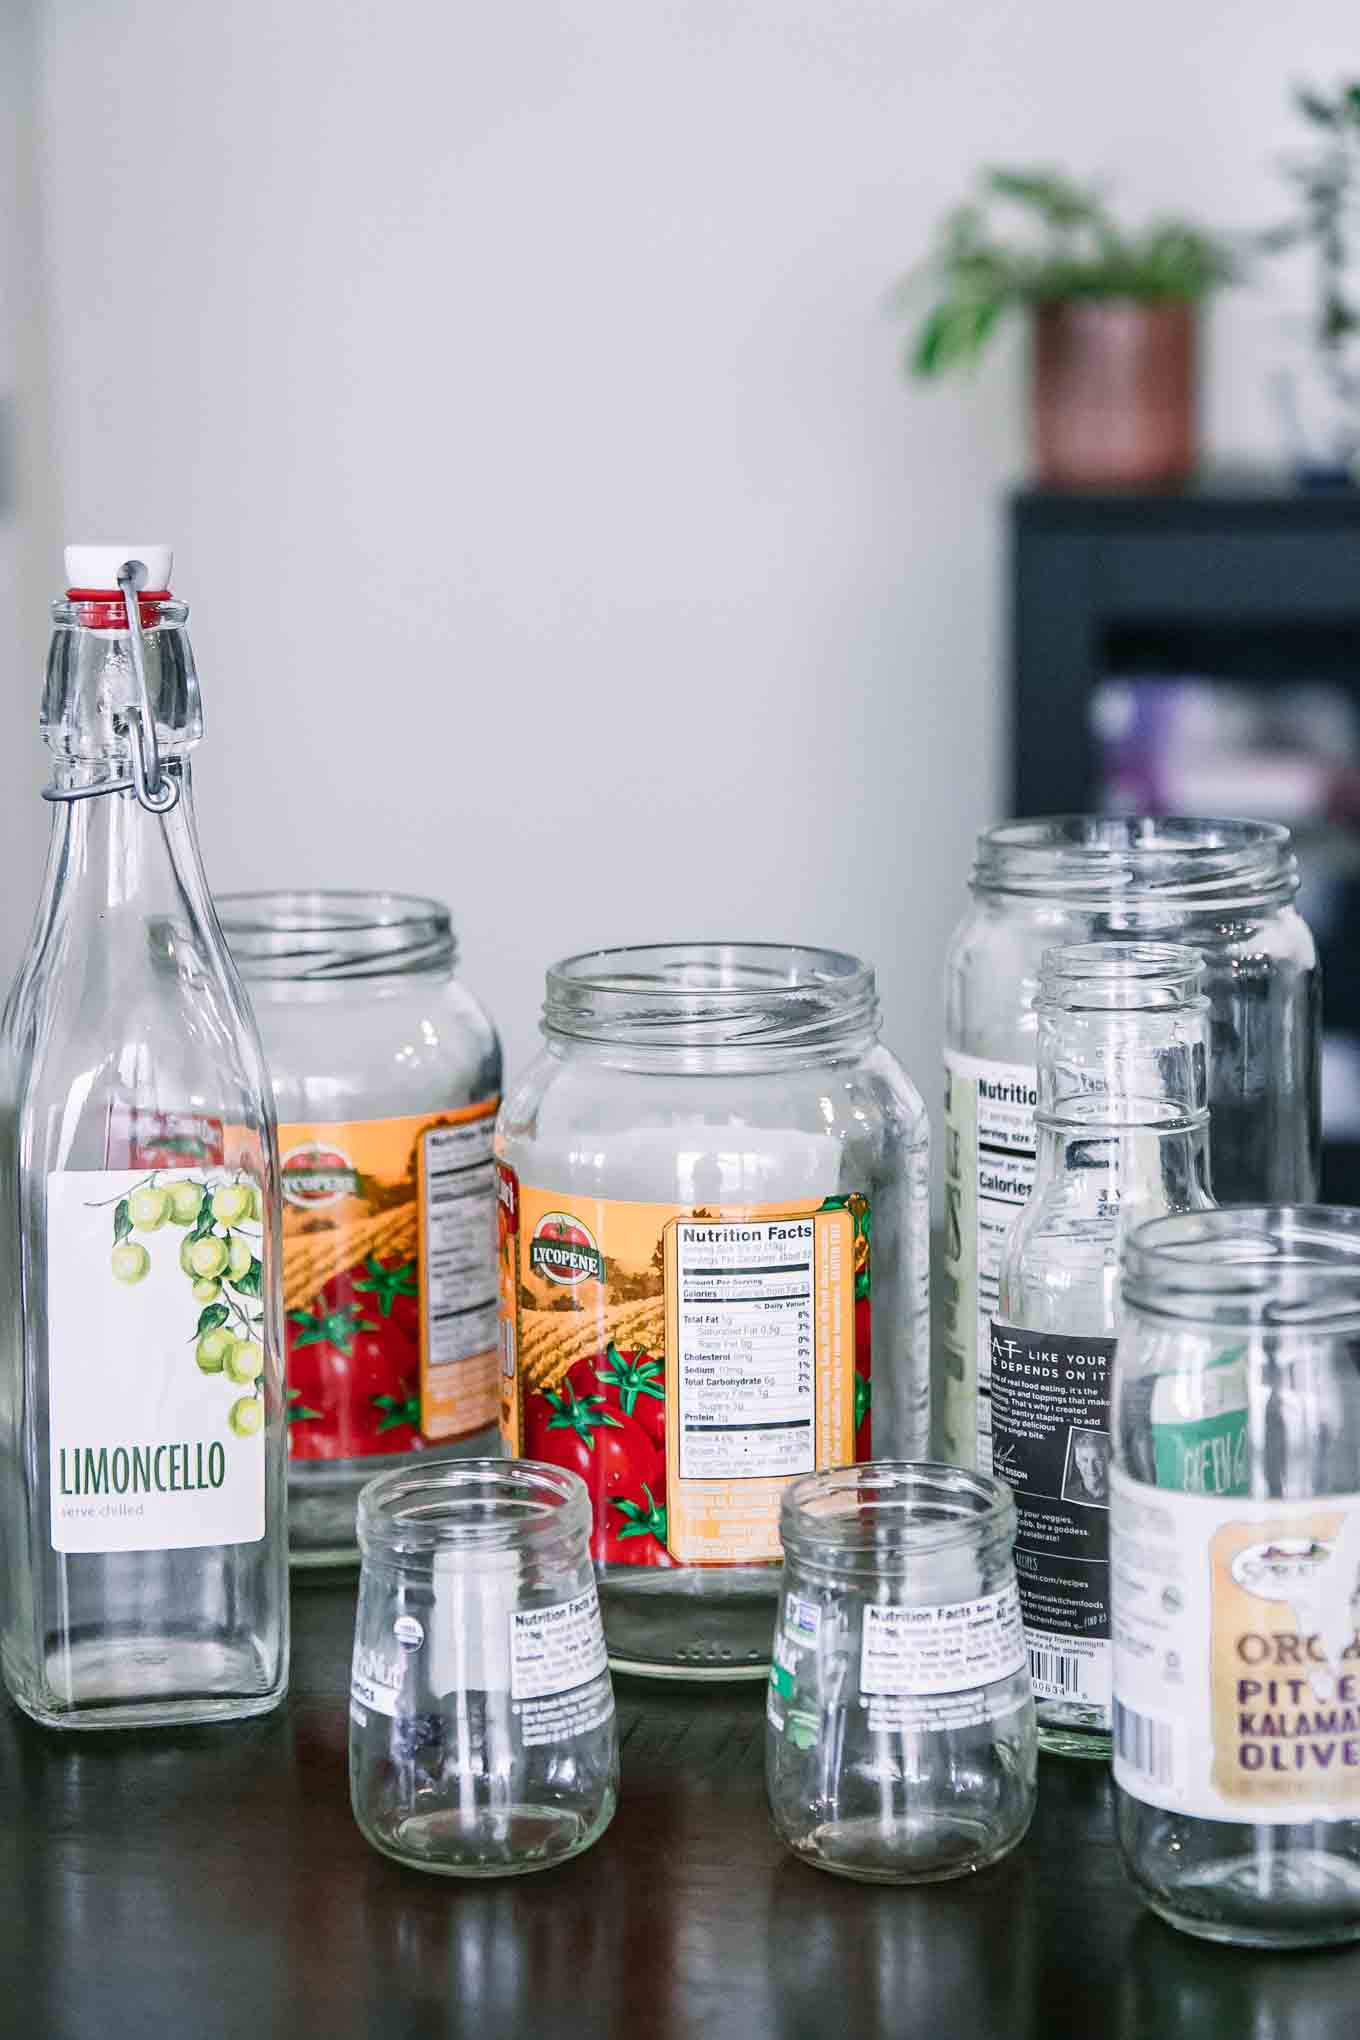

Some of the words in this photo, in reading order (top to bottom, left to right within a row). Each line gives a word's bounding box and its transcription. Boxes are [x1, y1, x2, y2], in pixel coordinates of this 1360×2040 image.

[979, 1171, 1034, 1197] Calories
[683, 1228, 762, 1243] Nutrition
[768, 1224, 813, 1241] Facts
[533, 1246, 599, 1274] LYCOPENE
[683, 1288, 718, 1298] Calories
[764, 1302, 784, 1311] Daily
[684, 1315, 703, 1324] Total
[705, 1315, 719, 1324] Fat
[684, 1353, 731, 1361] Cholesterol
[1028, 1350, 1059, 1364] LIKE
[1066, 1353, 1107, 1367] YOUR
[684, 1365, 715, 1374] Sodium
[1000, 1359, 1059, 1379] DEPENDS
[1065, 1369, 1086, 1381] ON
[685, 1377, 704, 1386] Total
[706, 1377, 762, 1387] Carbohydrate
[1021, 1380, 1039, 1390] food
[1032, 1392, 1067, 1405] toppings
[1068, 1396, 1086, 1405] that
[1033, 1403, 1050, 1413] why
[1055, 1406, 1088, 1416] created
[685, 1413, 715, 1422] Protein
[1011, 1409, 1034, 1421] pantry
[1035, 1412, 1064, 1424] staples
[1073, 1417, 1082, 1425] to
[1083, 1418, 1101, 1426] add
[1021, 1420, 1056, 1432] delicious
[60, 1441, 225, 1496] LIMONCELLO
[62, 1506, 96, 1518] serve
[1023, 1511, 1040, 1519] your
[1036, 1521, 1047, 1531] be
[514, 1608, 567, 1627] Nutrition
[869, 1609, 931, 1622] Nutrition
[1237, 1675, 1357, 1706] PITE
